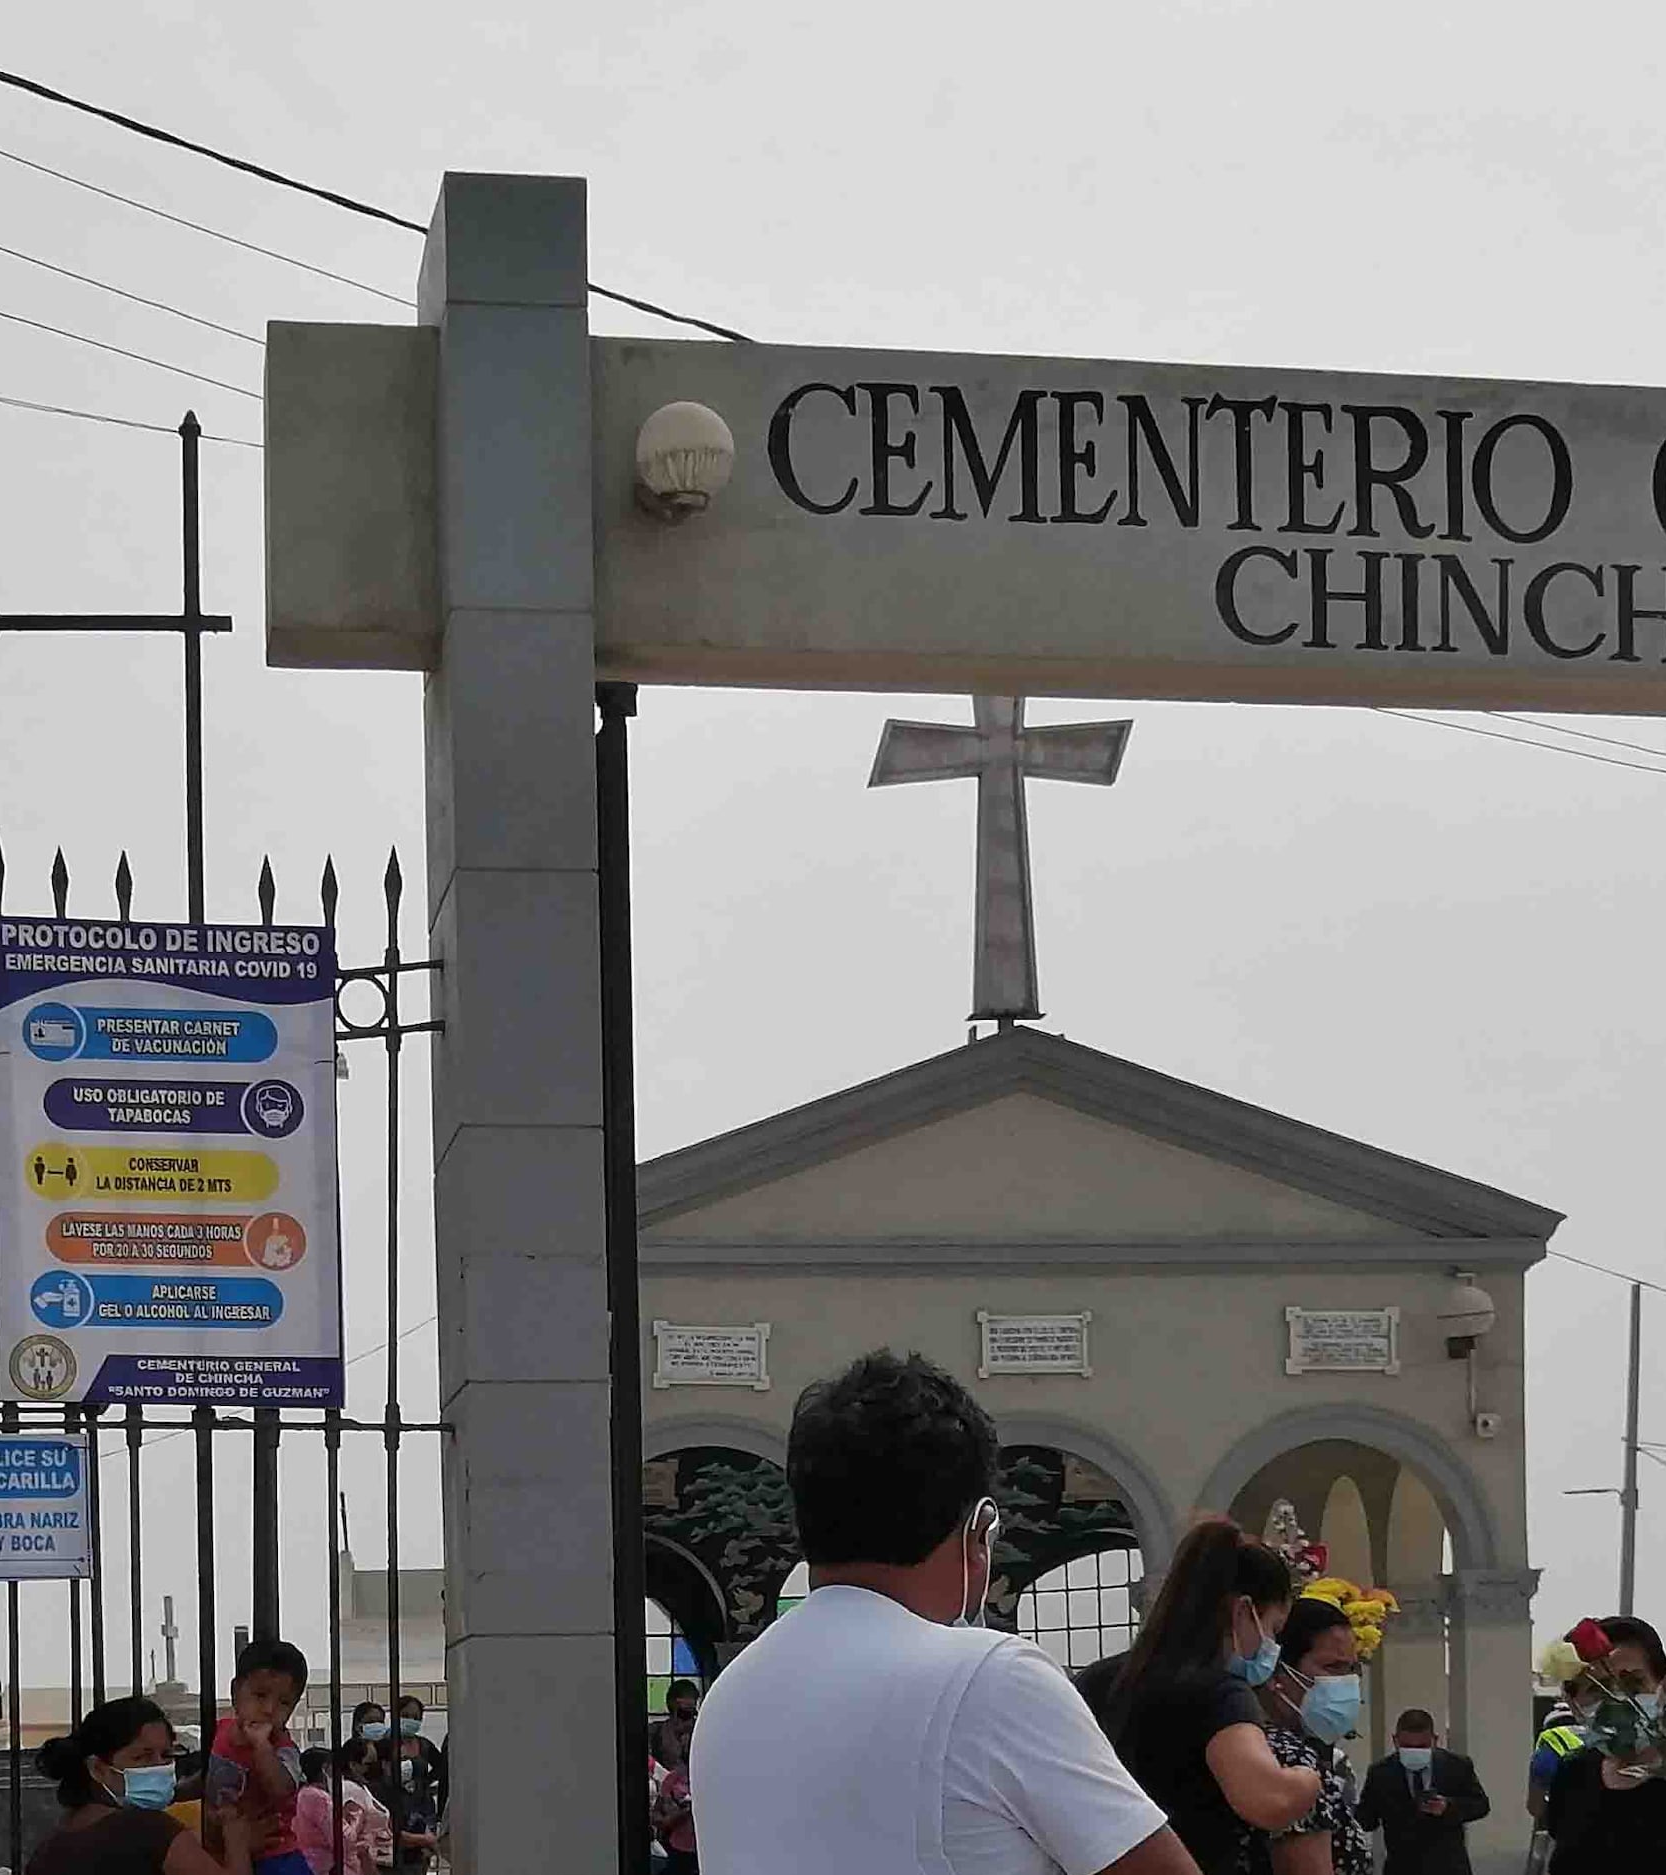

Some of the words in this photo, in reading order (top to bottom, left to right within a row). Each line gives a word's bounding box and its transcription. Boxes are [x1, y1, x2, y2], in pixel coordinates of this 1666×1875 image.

[767, 382, 1573, 544] CEMENTERIO
[1, 923, 158, 951] PROTOCOLO
[166, 929, 199, 952] DE
[207, 931, 321, 955] INGRESO
[5, 954, 126, 973] EMERGENCIA
[132, 957, 230, 977] SANITARIA
[235, 960, 291, 978] COVID
[296, 962, 318, 979] 19
[97, 1019, 180, 1035] PRESENTAR
[184, 1021, 240, 1036] CARNET
[112, 1038, 130, 1052] DE
[73, 1086, 103, 1102] USO
[107, 1088, 202, 1105] OBLIGATORIO
[205, 1091, 225, 1105] DE
[107, 1107, 191, 1124] TAPABOCAS
[129, 1158, 198, 1172] CONSERVAR
[96, 1176, 110, 1190] LA
[114, 1176, 176, 1192] DISTANCIA
[179, 1179, 195, 1191] DE
[198, 1179, 204, 1192] 2
[208, 1179, 232, 1192] MTS
[105, 1223, 124, 1237] LAS
[128, 1224, 164, 1238] MANOS
[167, 1225, 194, 1238] CADA
[206, 1226, 241, 1240] HORAS
[93, 1243, 113, 1257] POR
[132, 1245, 140, 1257] A
[157, 1245, 213, 1259] SEGUNDOS
[152, 1285, 216, 1300] APLICARSE
[99, 1304, 121, 1317] GEL
[125, 1305, 132, 1317] O
[136, 1305, 190, 1318] ALCOHOL
[194, 1306, 208, 1319] AL
[212, 1306, 270, 1320] INGRESAR
[137, 1360, 229, 1371] CEMENTERIO
[234, 1361, 301, 1372] GENERAL
[175, 1373, 195, 1383] DE
[198, 1374, 264, 1384] CHINCHA
[167, 1387, 235, 1397] DOMINGO
[239, 1387, 258, 1397] DE
[41, 1450, 66, 1467] SU
[30, 1513, 80, 1528] NARIZ
[11, 1535, 56, 1551] BOCA
